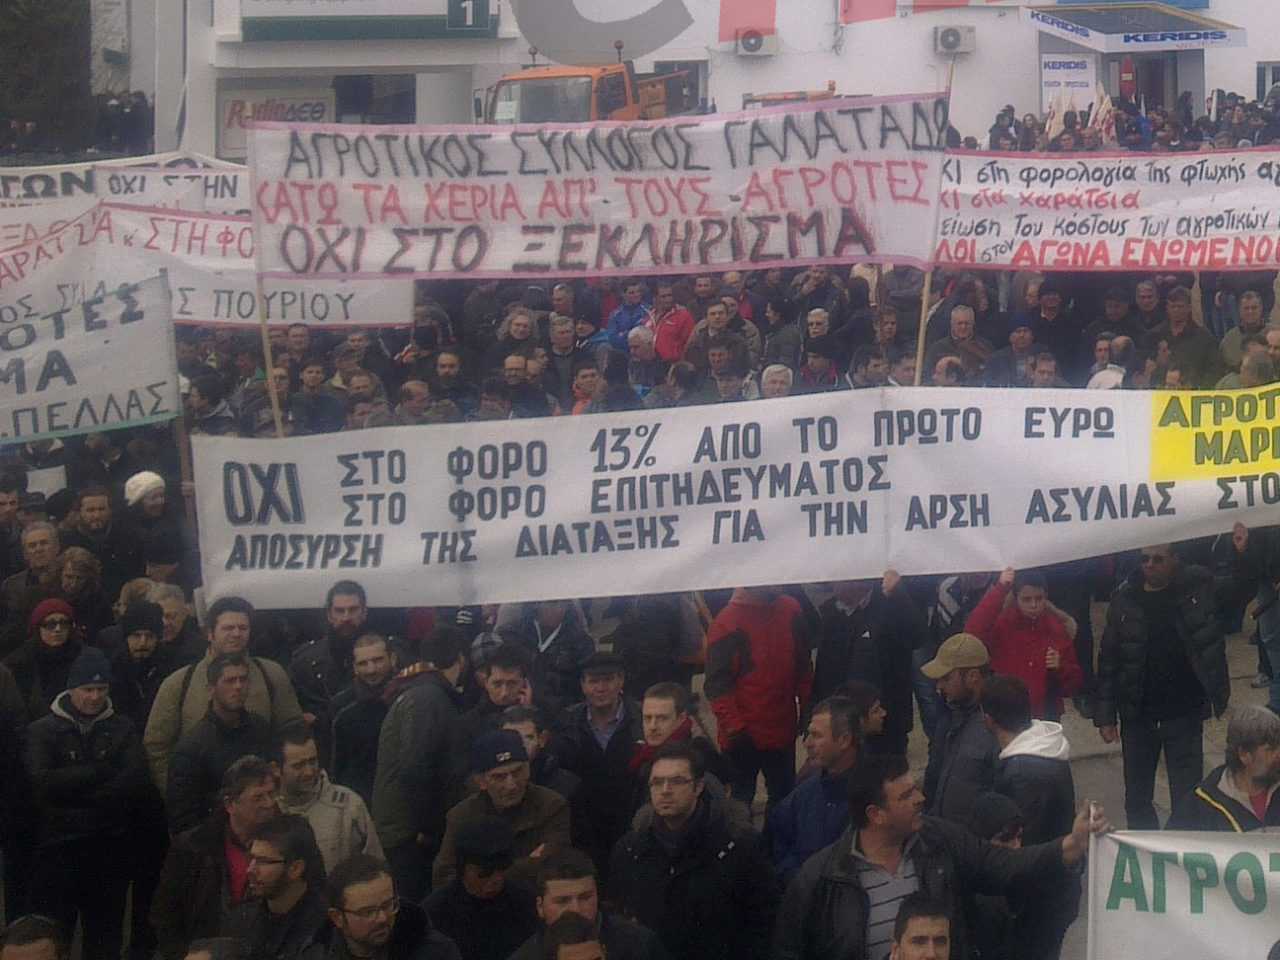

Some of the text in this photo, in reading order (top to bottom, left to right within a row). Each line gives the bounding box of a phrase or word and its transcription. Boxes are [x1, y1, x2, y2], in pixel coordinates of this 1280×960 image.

[460, 0, 473, 26] 1
[1030, 10, 1090, 38] KERIDIS
[1123, 30, 1228, 43] KERIDIS
[1043, 60, 1088, 70] KERIDIS
[284, 97, 949, 179] ΑΓΡΟΤΙΚΟΣ ΣΥΛΛΟΓΟΣ ΓΑΛΑΤΑΔΩ
[108, 173, 147, 196] ΟΧΙ
[352, 183, 408, 225] ΤΑ
[424, 181, 527, 223] ΧΕΡΙΑ
[615, 176, 723, 219] ΤΟΥΣ
[740, 159, 931, 214] ΑΓΡΟΤΕΣ
[1018, 158, 1137, 189] φορολογία
[216, 225, 254, 259] ΦΟ
[280, 206, 877, 274] ΟΧΙ ΣΤΟ ΞΕΚΛΗΡΙΣΜΑ
[940, 212, 1001, 238] είωση
[935, 238, 976, 264] ΛΟΙ
[1010, 238, 1111, 268] ΑΓΩΝΑ
[0, 282, 145, 352] ΟΤΕΣ
[213, 289, 356, 321] ΠΟΥΡΙΟΥ
[0, 350, 78, 395] ΜΑ
[12, 381, 169, 437] ΠΕΛΛΑΣ
[337, 406, 1115, 488] ΣΤΟ ΦΟΡΟ 13% ΑΠΟ ΤΟ ΠΡΩΤΟ ΕΥΡΩ
[221, 460, 306, 527] ΟΧΙ
[342, 454, 892, 527] ΣΤΟ ΦΟΡΟ ΕΠΙΤΗΔΕΥΜΑΤΟΣ
[225, 532, 384, 571] ΑΠΟΣΥΡΣΗ
[420, 528, 478, 565] ΤΗΣ
[515, 514, 680, 558] ΔΙΑΤΑΞΗΣ
[712, 508, 766, 544] ΓΙΑ
[801, 500, 869, 537] ΤΗΝ
[905, 493, 991, 531] ΑΡΣΗ
[1024, 480, 1176, 525] ΑΣΥΛΙΑΣ
[1216, 471, 1280, 510] ΣΤΟ
